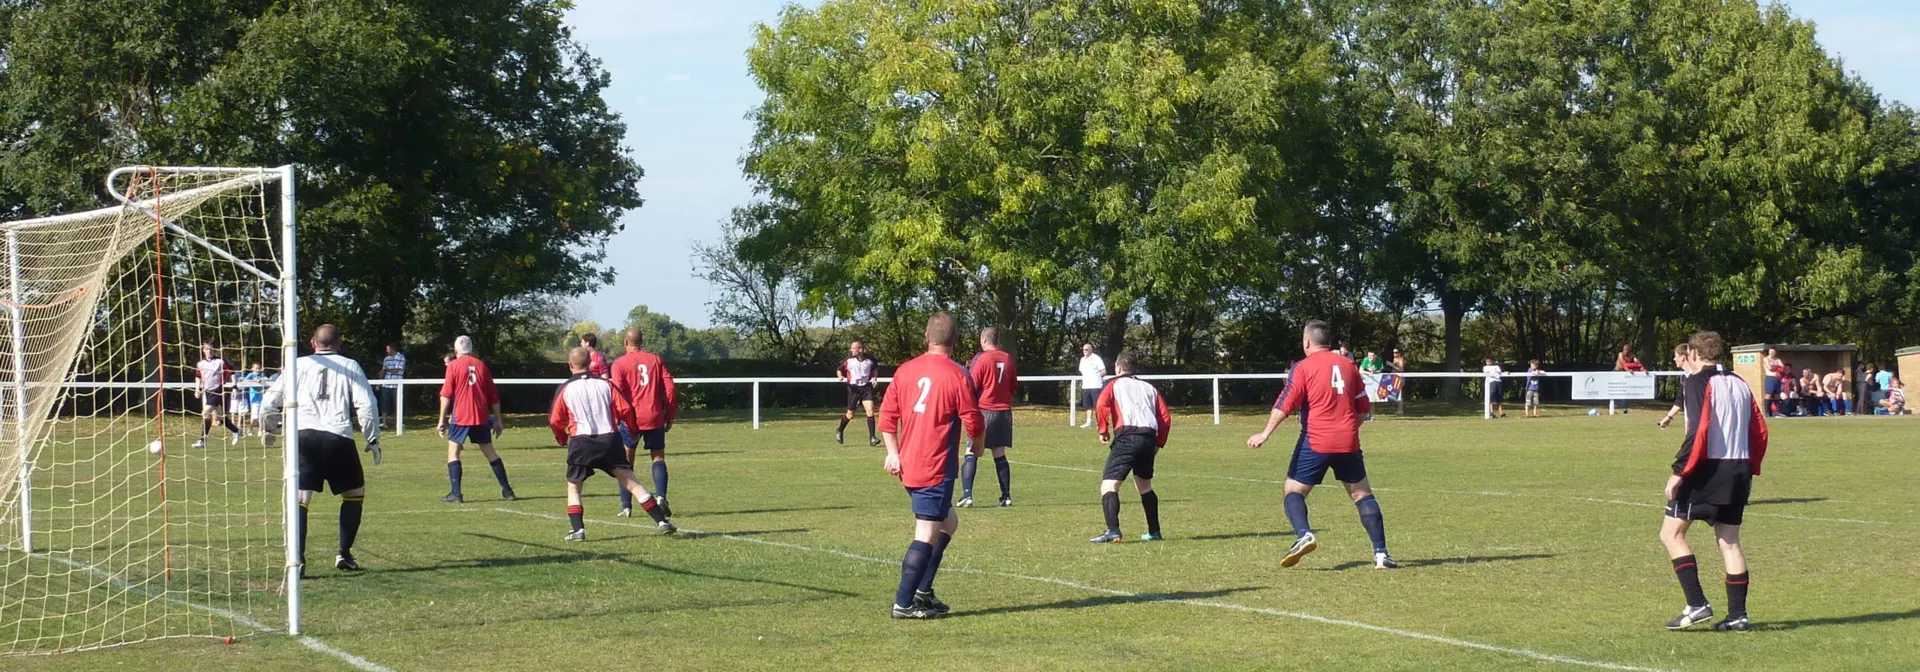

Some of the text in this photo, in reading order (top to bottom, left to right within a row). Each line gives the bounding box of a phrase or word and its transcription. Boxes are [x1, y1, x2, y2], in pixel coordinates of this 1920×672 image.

[318, 367, 330, 400] 1
[468, 365, 477, 386] 5
[637, 363, 650, 387] 3
[996, 362, 1005, 384] 7
[1331, 364, 1345, 395] 4
[913, 376, 931, 413] 2
